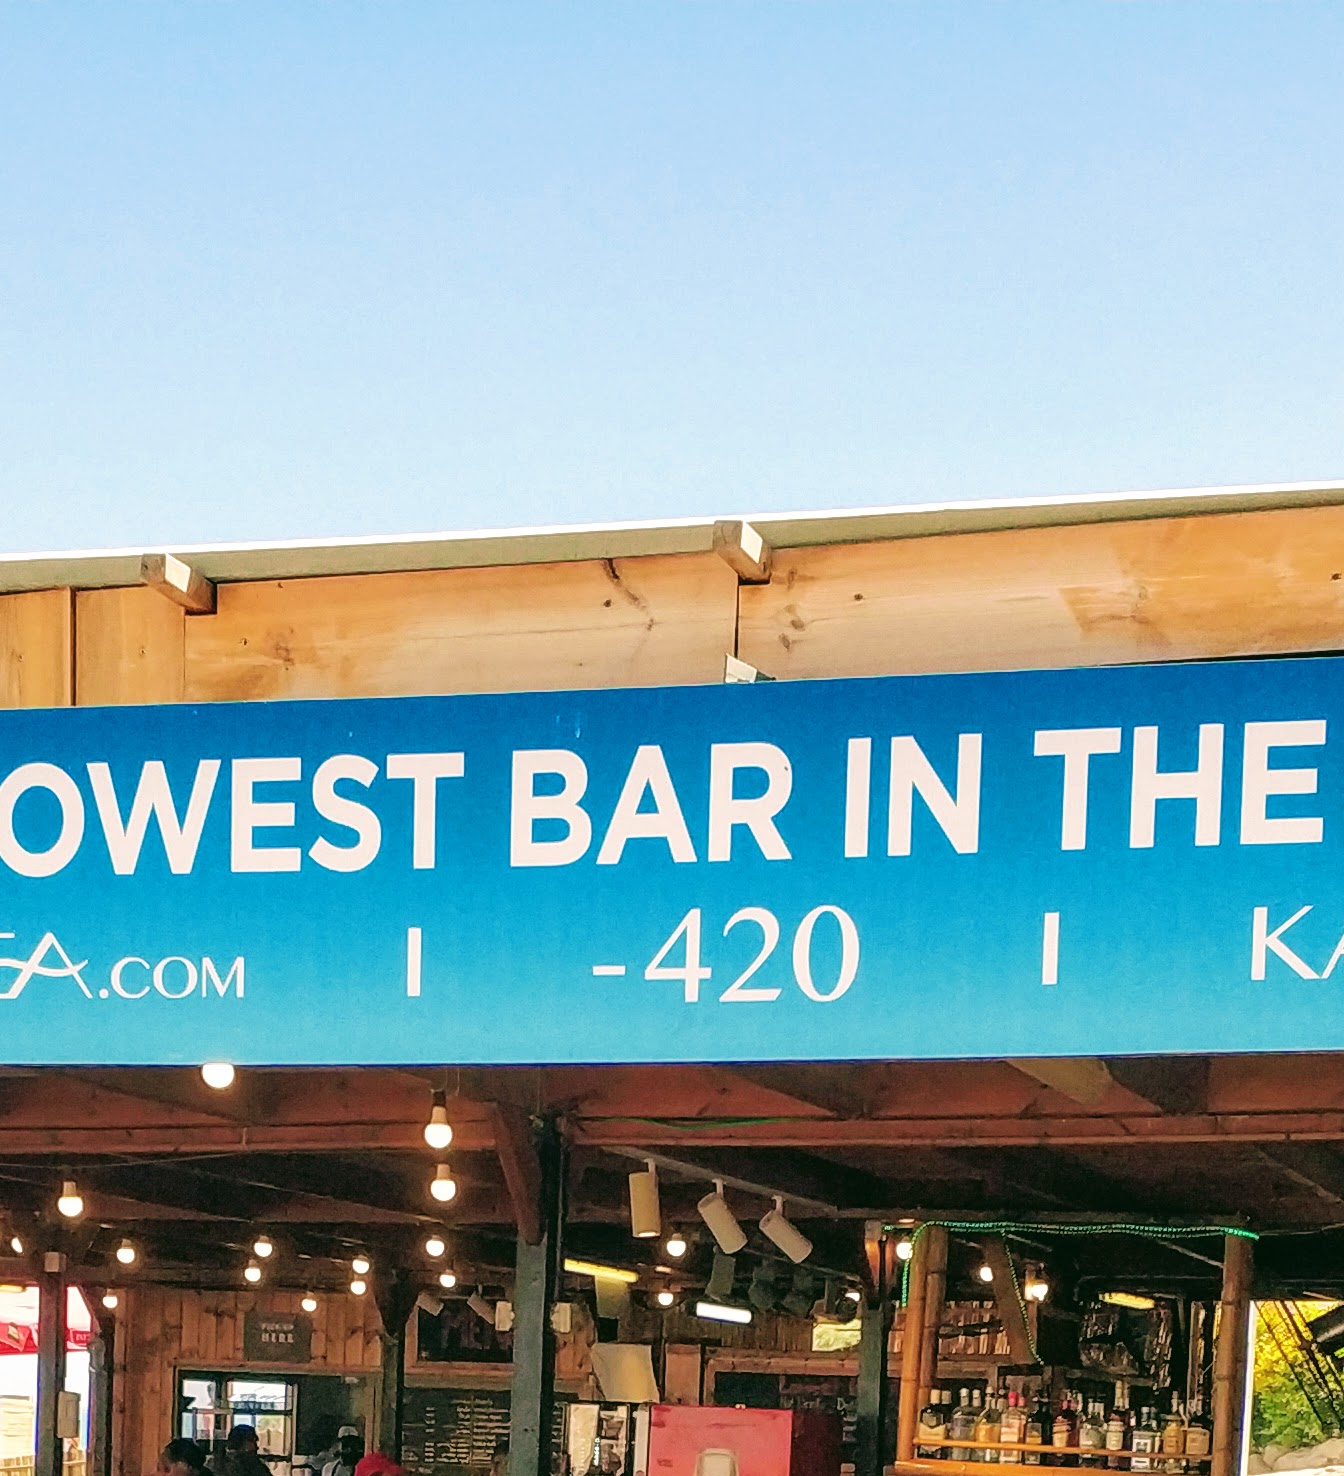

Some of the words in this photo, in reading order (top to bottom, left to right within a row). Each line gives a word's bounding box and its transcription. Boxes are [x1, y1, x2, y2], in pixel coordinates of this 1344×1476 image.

[509, 742, 794, 868] BAR
[843, 733, 983, 859] IN
[1032, 719, 1328, 852] THE
[591, 904, 861, 1004] -420
